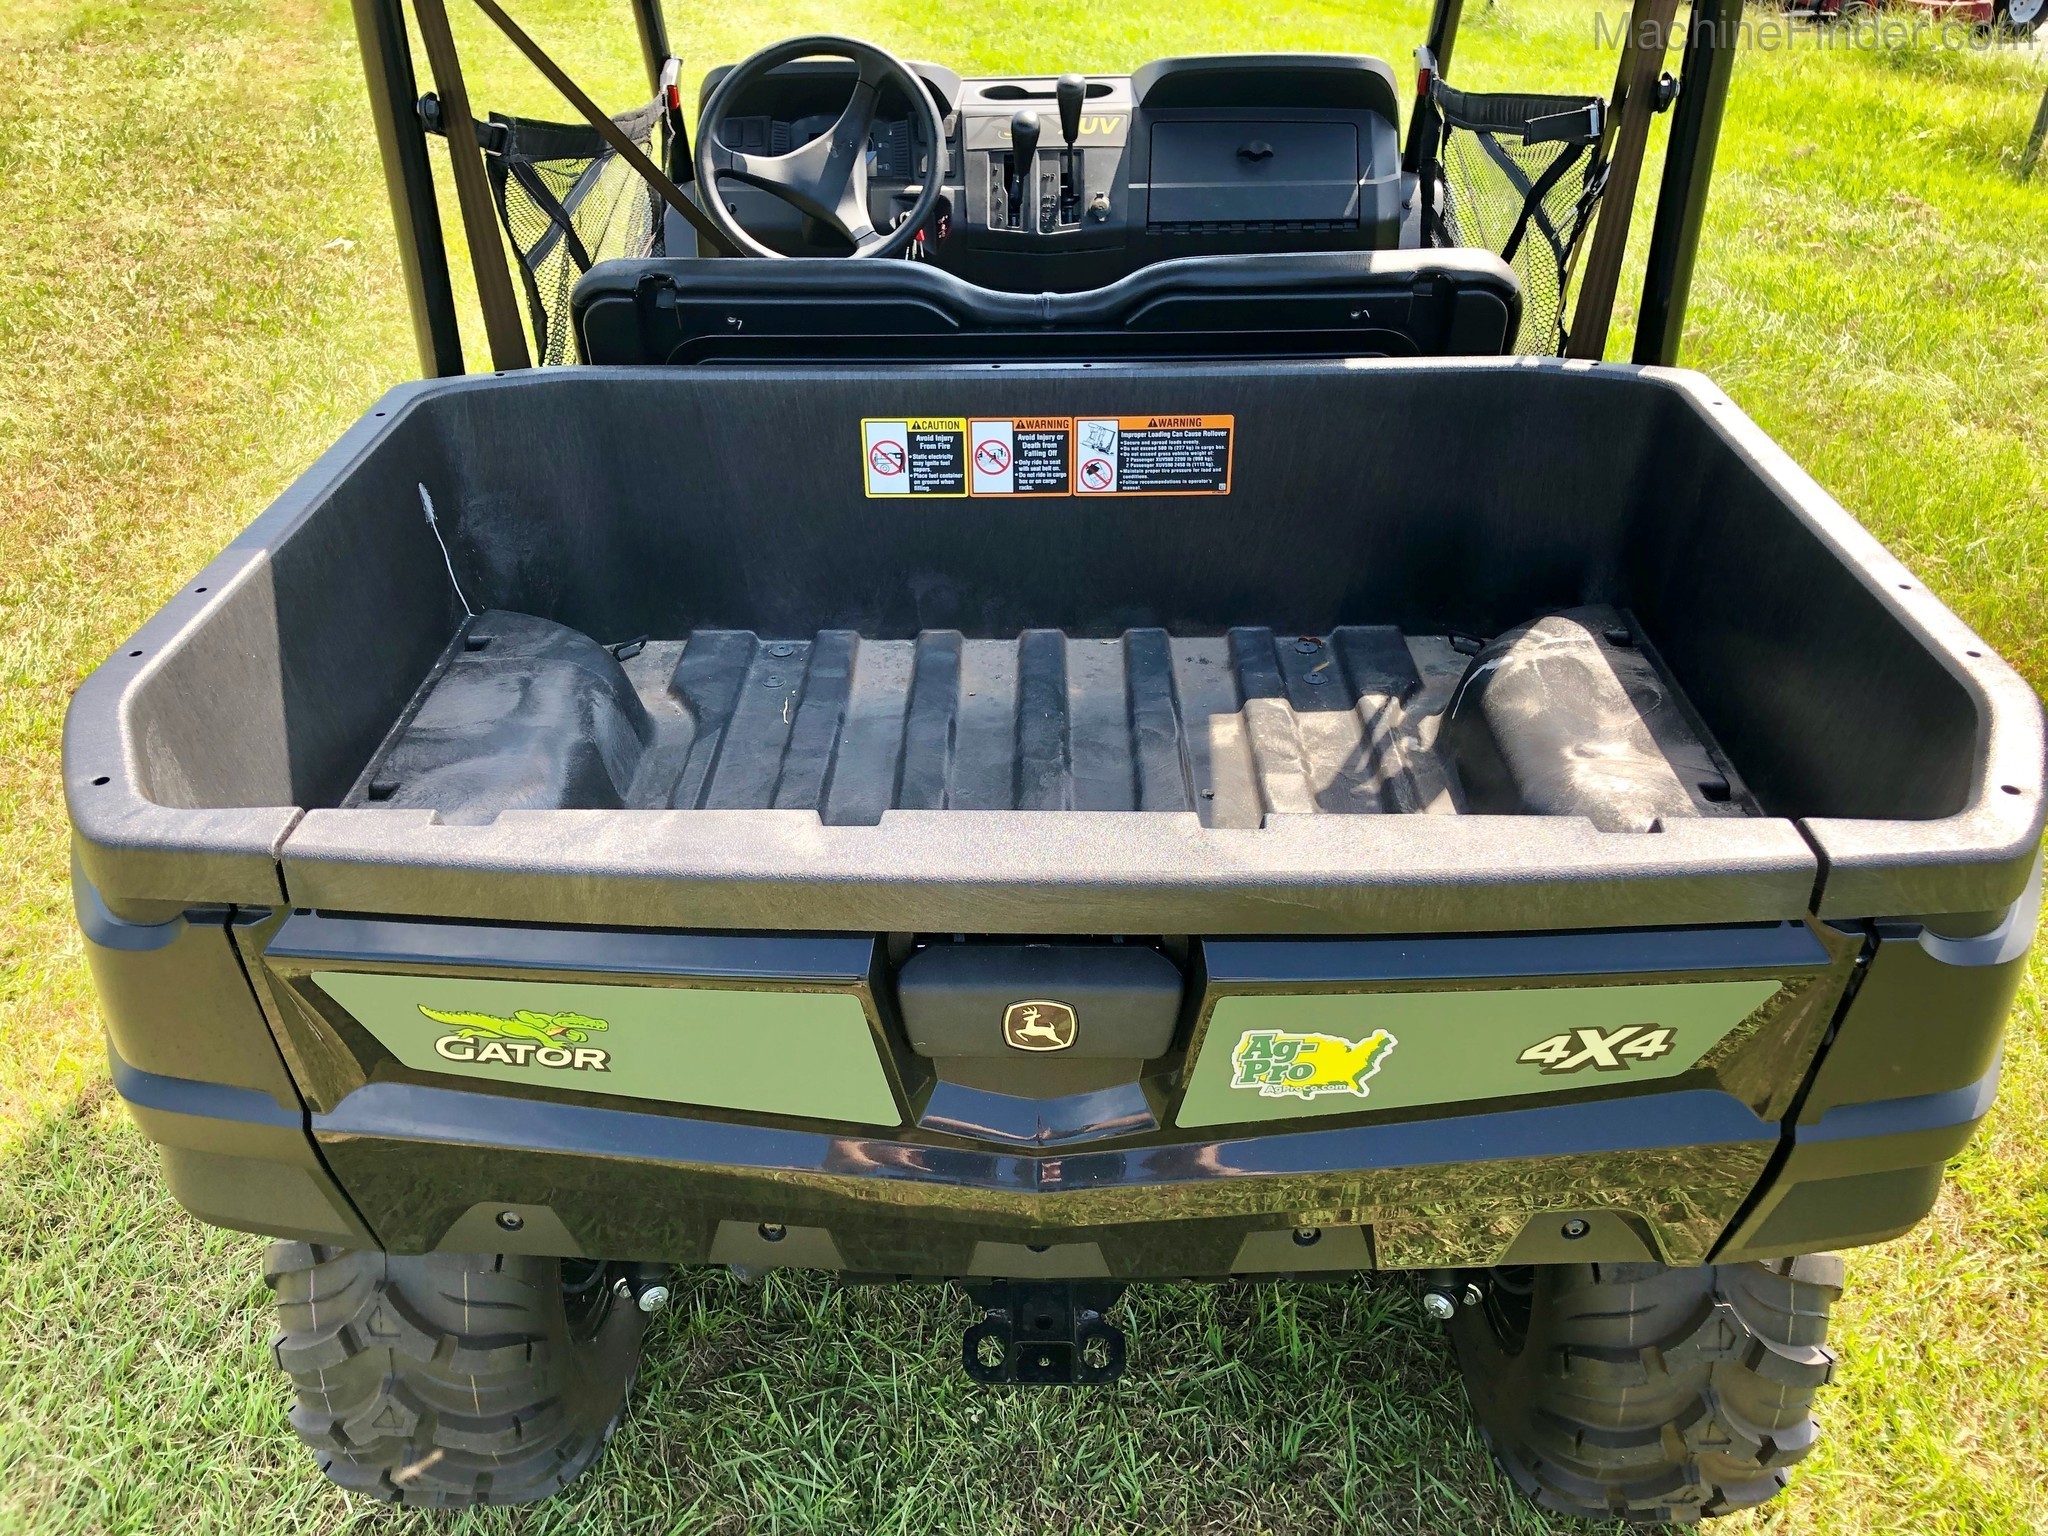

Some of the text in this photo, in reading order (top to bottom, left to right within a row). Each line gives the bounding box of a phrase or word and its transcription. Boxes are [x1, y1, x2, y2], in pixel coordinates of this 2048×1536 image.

[922, 421, 960, 430] CAUTION
[1026, 420, 1069, 429] WARNING
[1158, 418, 1202, 427] WARNING
[916, 434, 954, 443] Avoid Injury
[1036, 434, 1055, 442] Injury
[1121, 431, 1147, 439] Improper
[1024, 450, 1046, 458] Falling
[435, 1035, 608, 1071] GATOR
[1240, 1034, 1318, 1063] Ag-
[1519, 1026, 1673, 1071] 4X4
[1239, 1060, 1315, 1084] Pro
[1265, 1084, 1348, 1094] AgProCo.com
